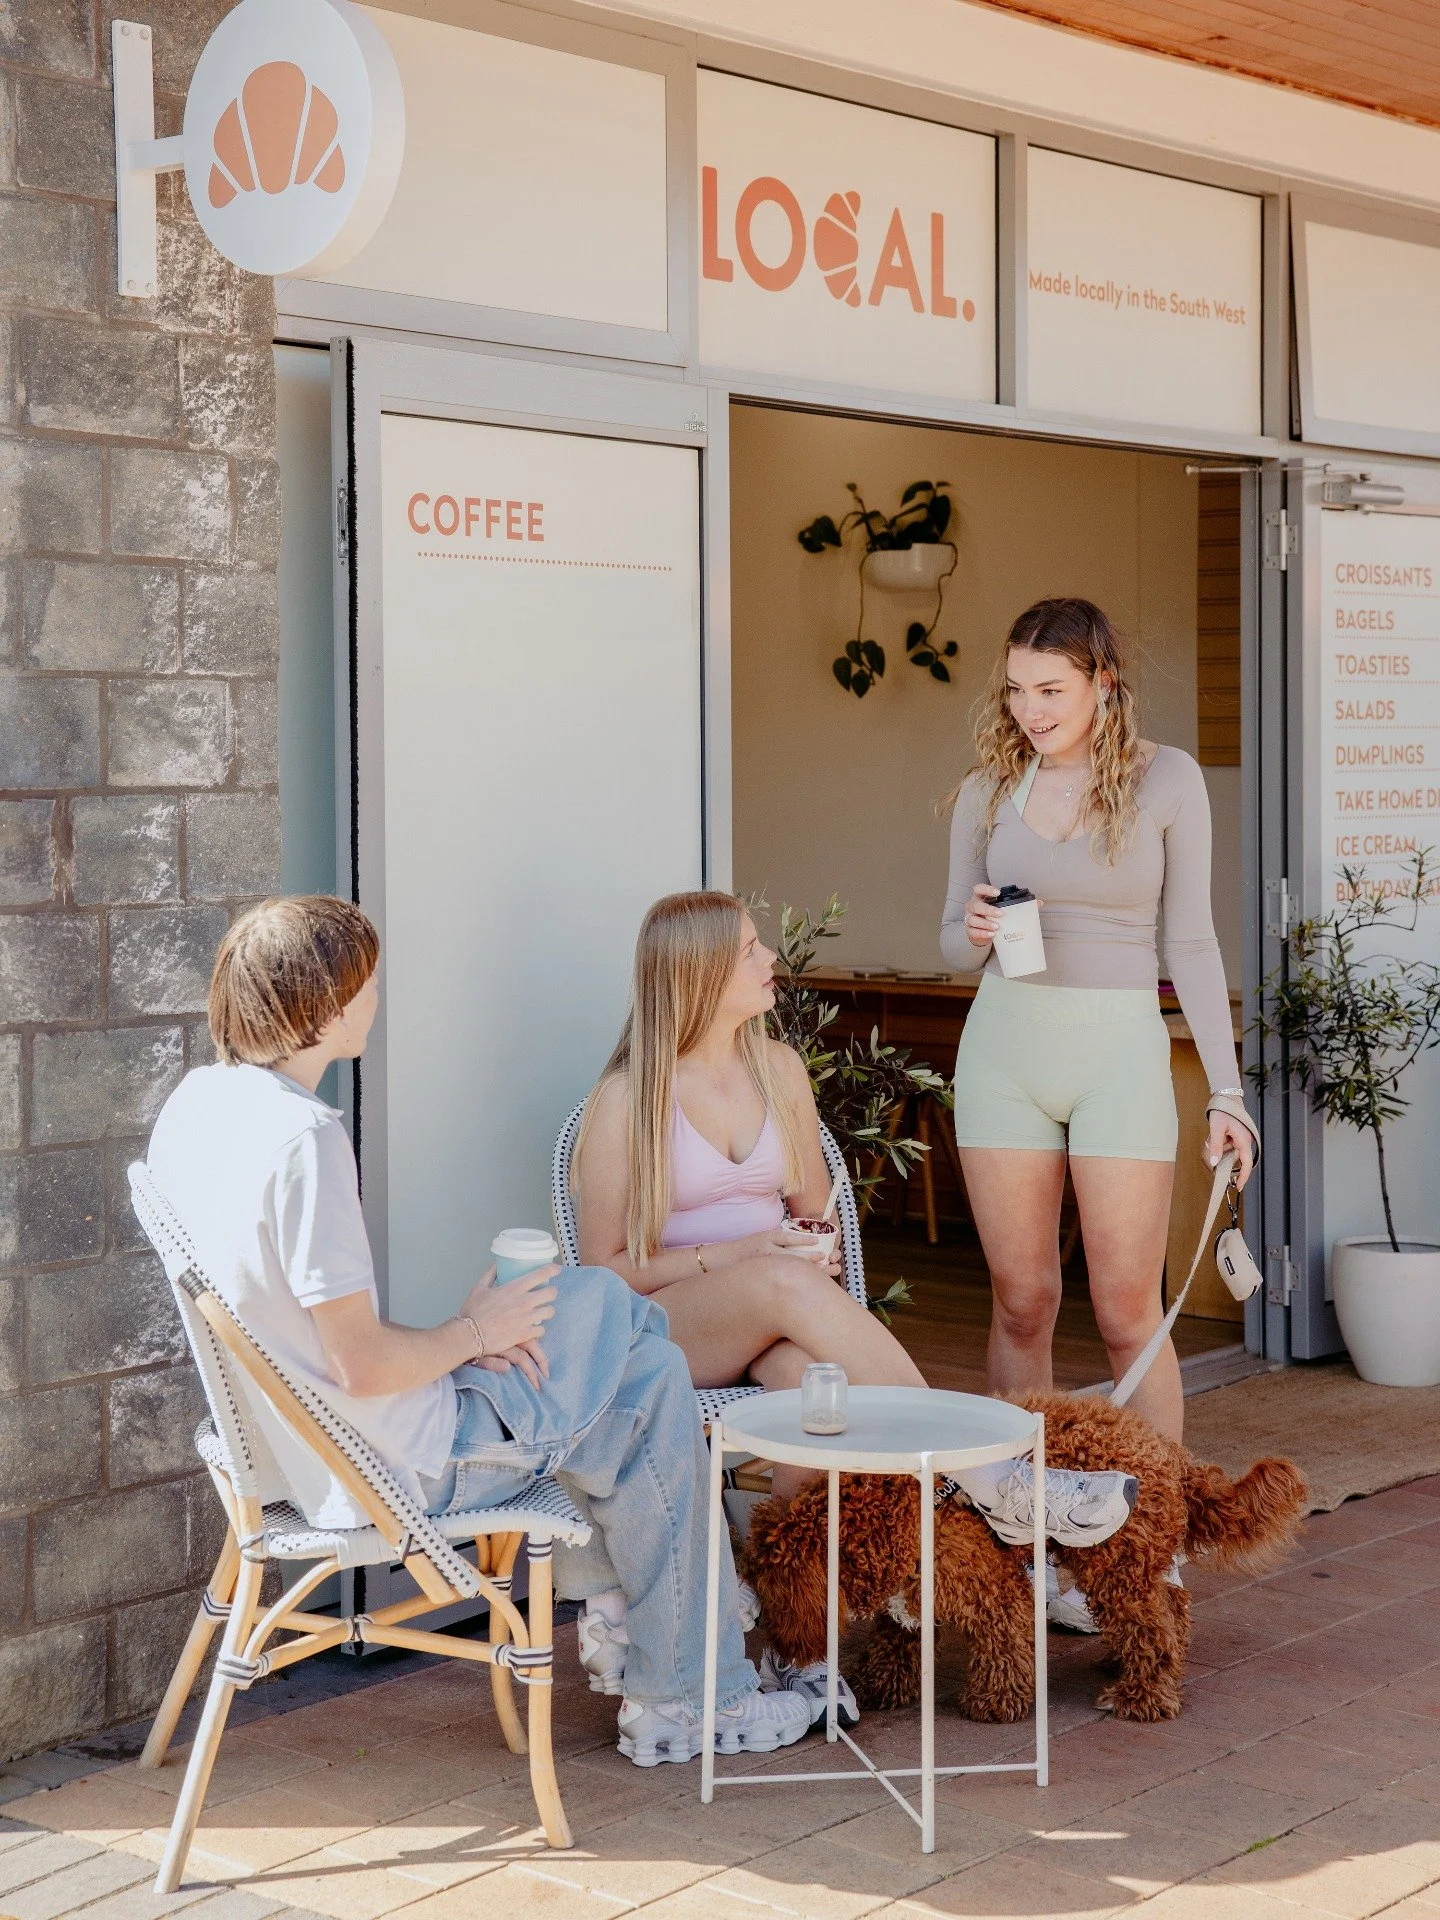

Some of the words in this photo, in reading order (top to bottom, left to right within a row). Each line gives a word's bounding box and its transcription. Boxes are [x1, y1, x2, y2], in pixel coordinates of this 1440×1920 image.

[1029, 269, 1071, 295] Made
[1075, 275, 1123, 310] locally
[1127, 284, 1140, 307] in
[1143, 288, 1167, 312] the
[1170, 292, 1210, 319] South
[1213, 299, 1246, 325] West
[684, 423, 708, 432] SIGNS
[407, 492, 545, 542] COFFEE
[1335, 563, 1432, 587] CROISSANTS
[1335, 608, 1395, 631] BAGELS
[1335, 654, 1410, 676] TOASTIES
[1335, 699, 1396, 721] SALADS
[1335, 744, 1425, 766] DUMPLINGS
[1336, 790, 1374, 811] TAKE
[1379, 788, 1422, 809] HOME
[1336, 836, 1359, 857] ICE
[1363, 834, 1416, 855] CREAM
